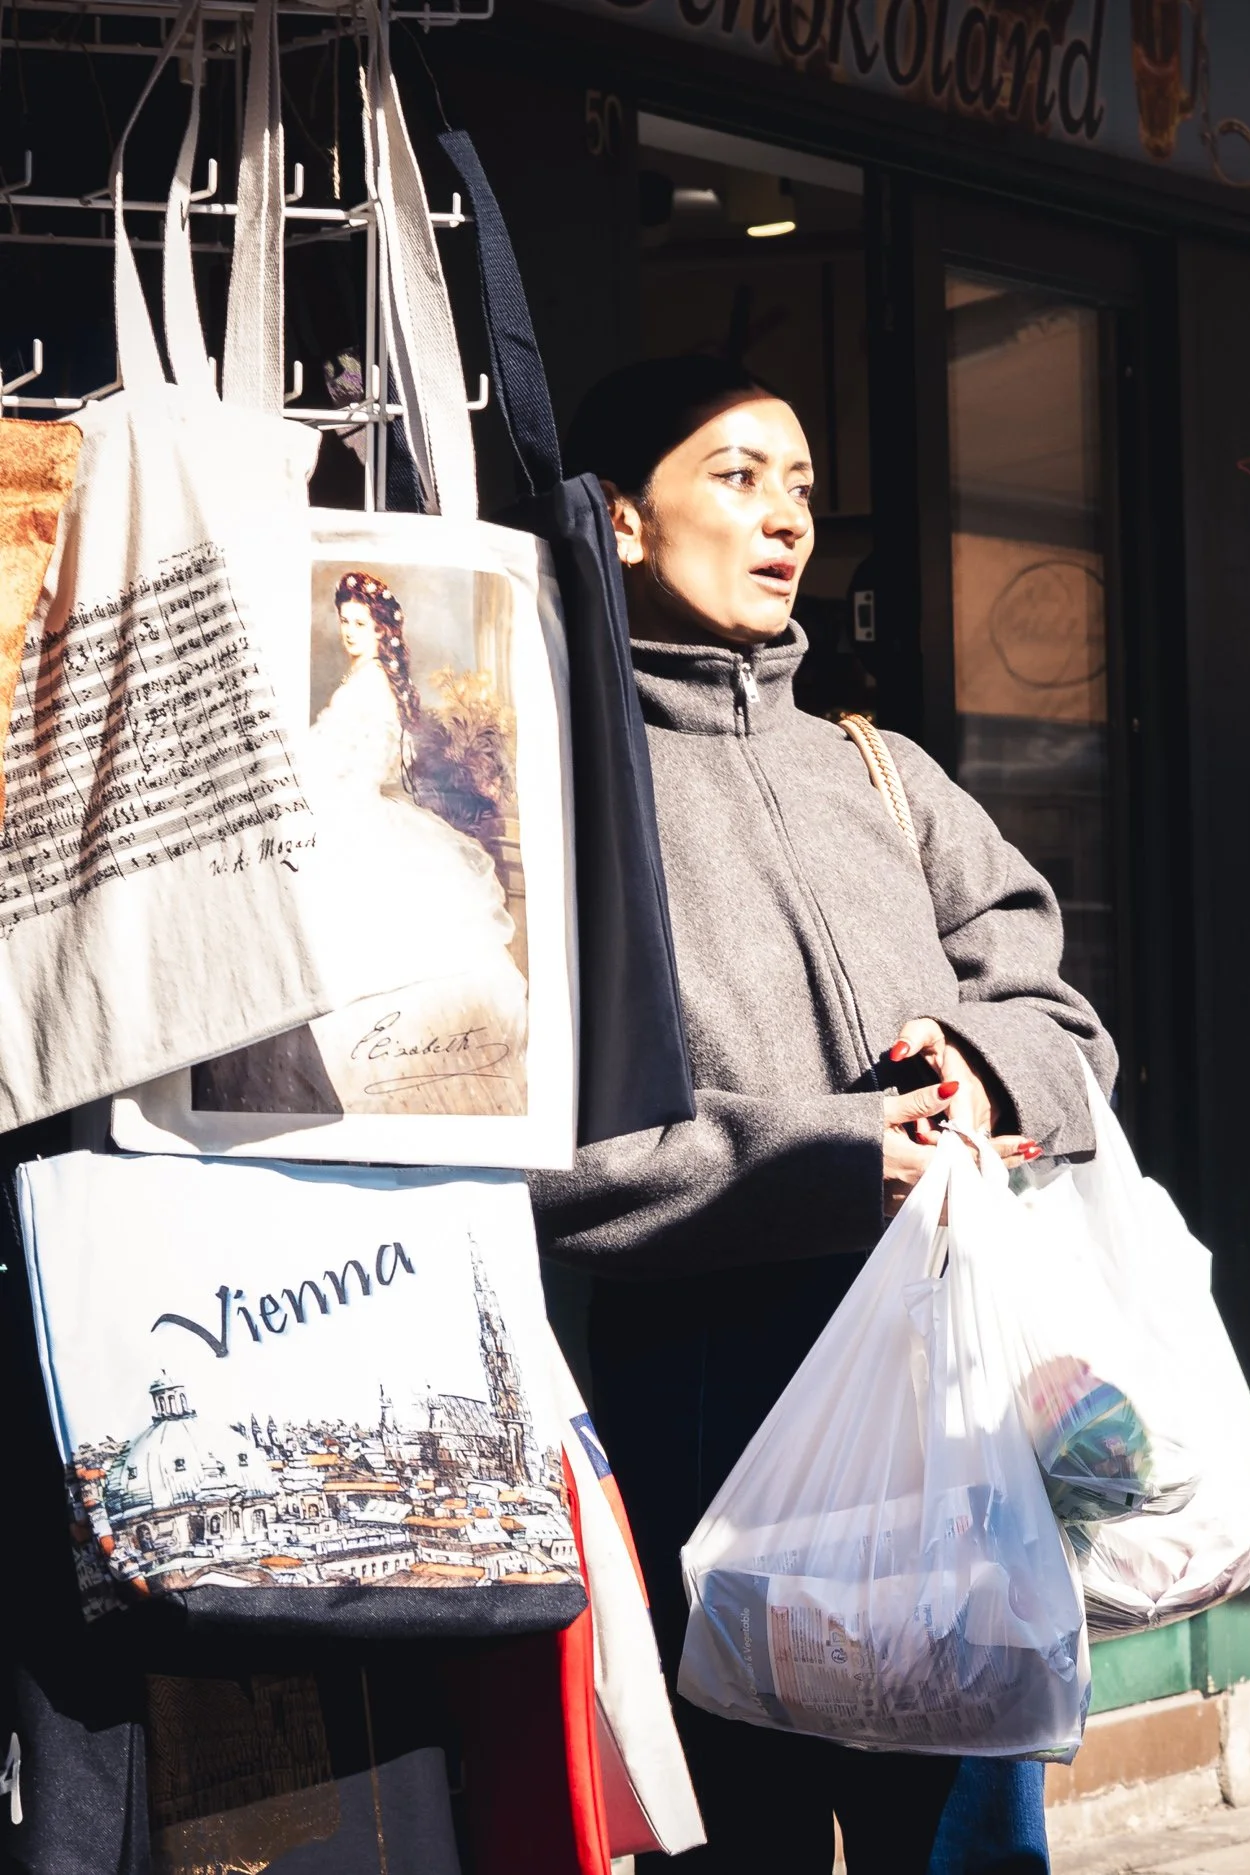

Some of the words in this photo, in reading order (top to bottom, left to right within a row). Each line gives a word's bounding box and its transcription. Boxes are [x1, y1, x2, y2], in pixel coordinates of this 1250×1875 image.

[603, 0, 1105, 140] okoland
[584, 87, 626, 158] 50
[151, 1242, 415, 1358] Vienna
[740, 1607, 752, 1654] Vegetable
